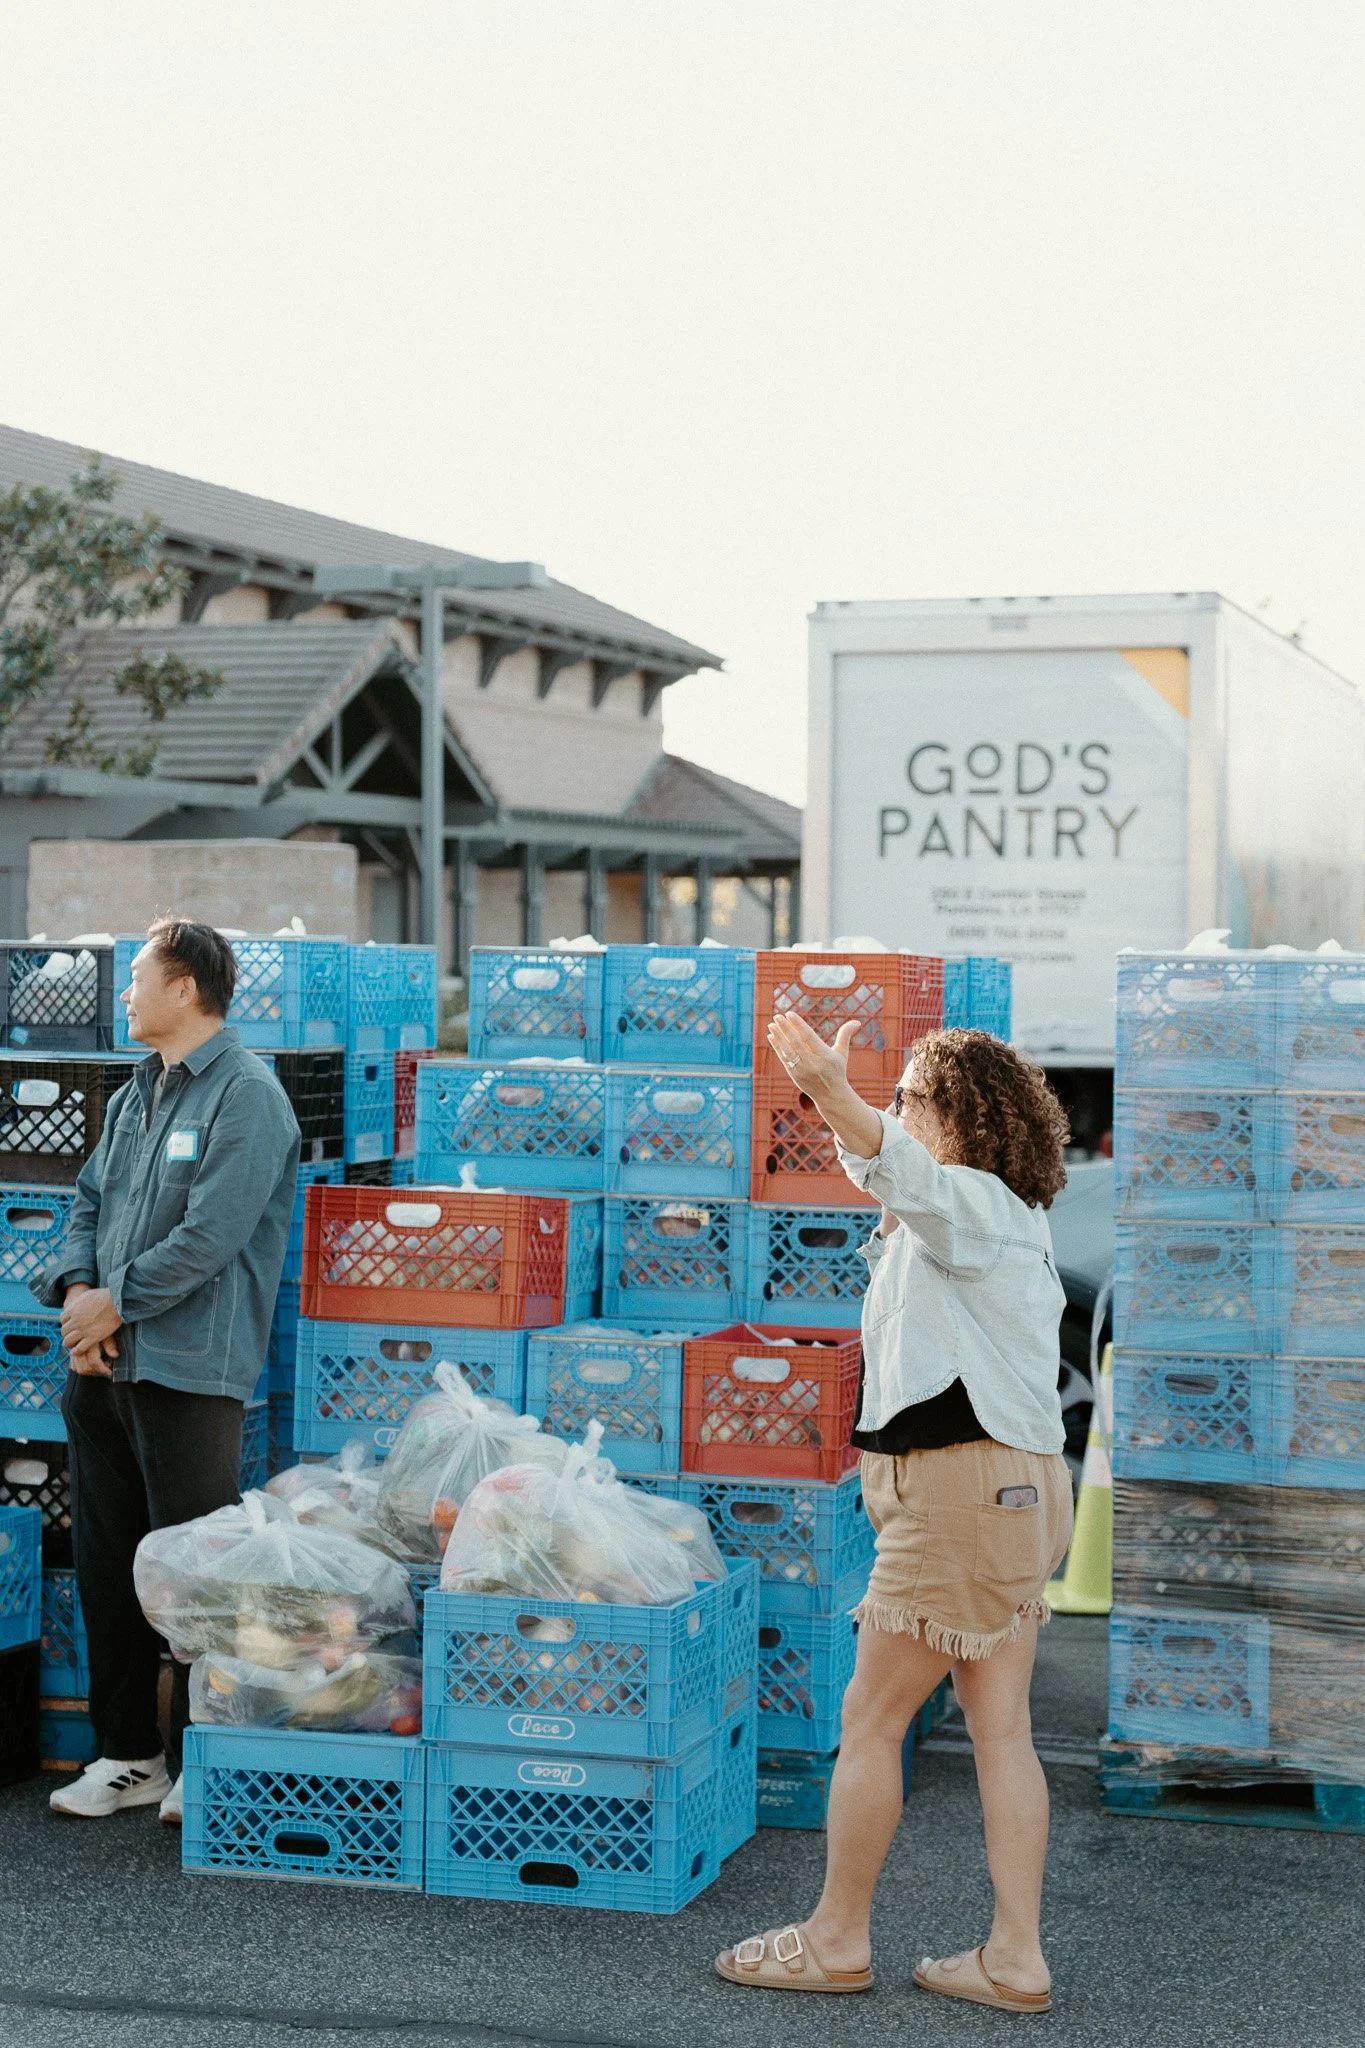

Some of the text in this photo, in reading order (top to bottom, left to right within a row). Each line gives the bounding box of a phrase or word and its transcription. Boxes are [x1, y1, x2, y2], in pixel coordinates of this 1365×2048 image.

[907, 742, 1111, 796] GOD'S
[877, 804, 1139, 858] PANTRY
[521, 1716, 560, 1734] Pace
[533, 1766, 572, 1784] Pace
